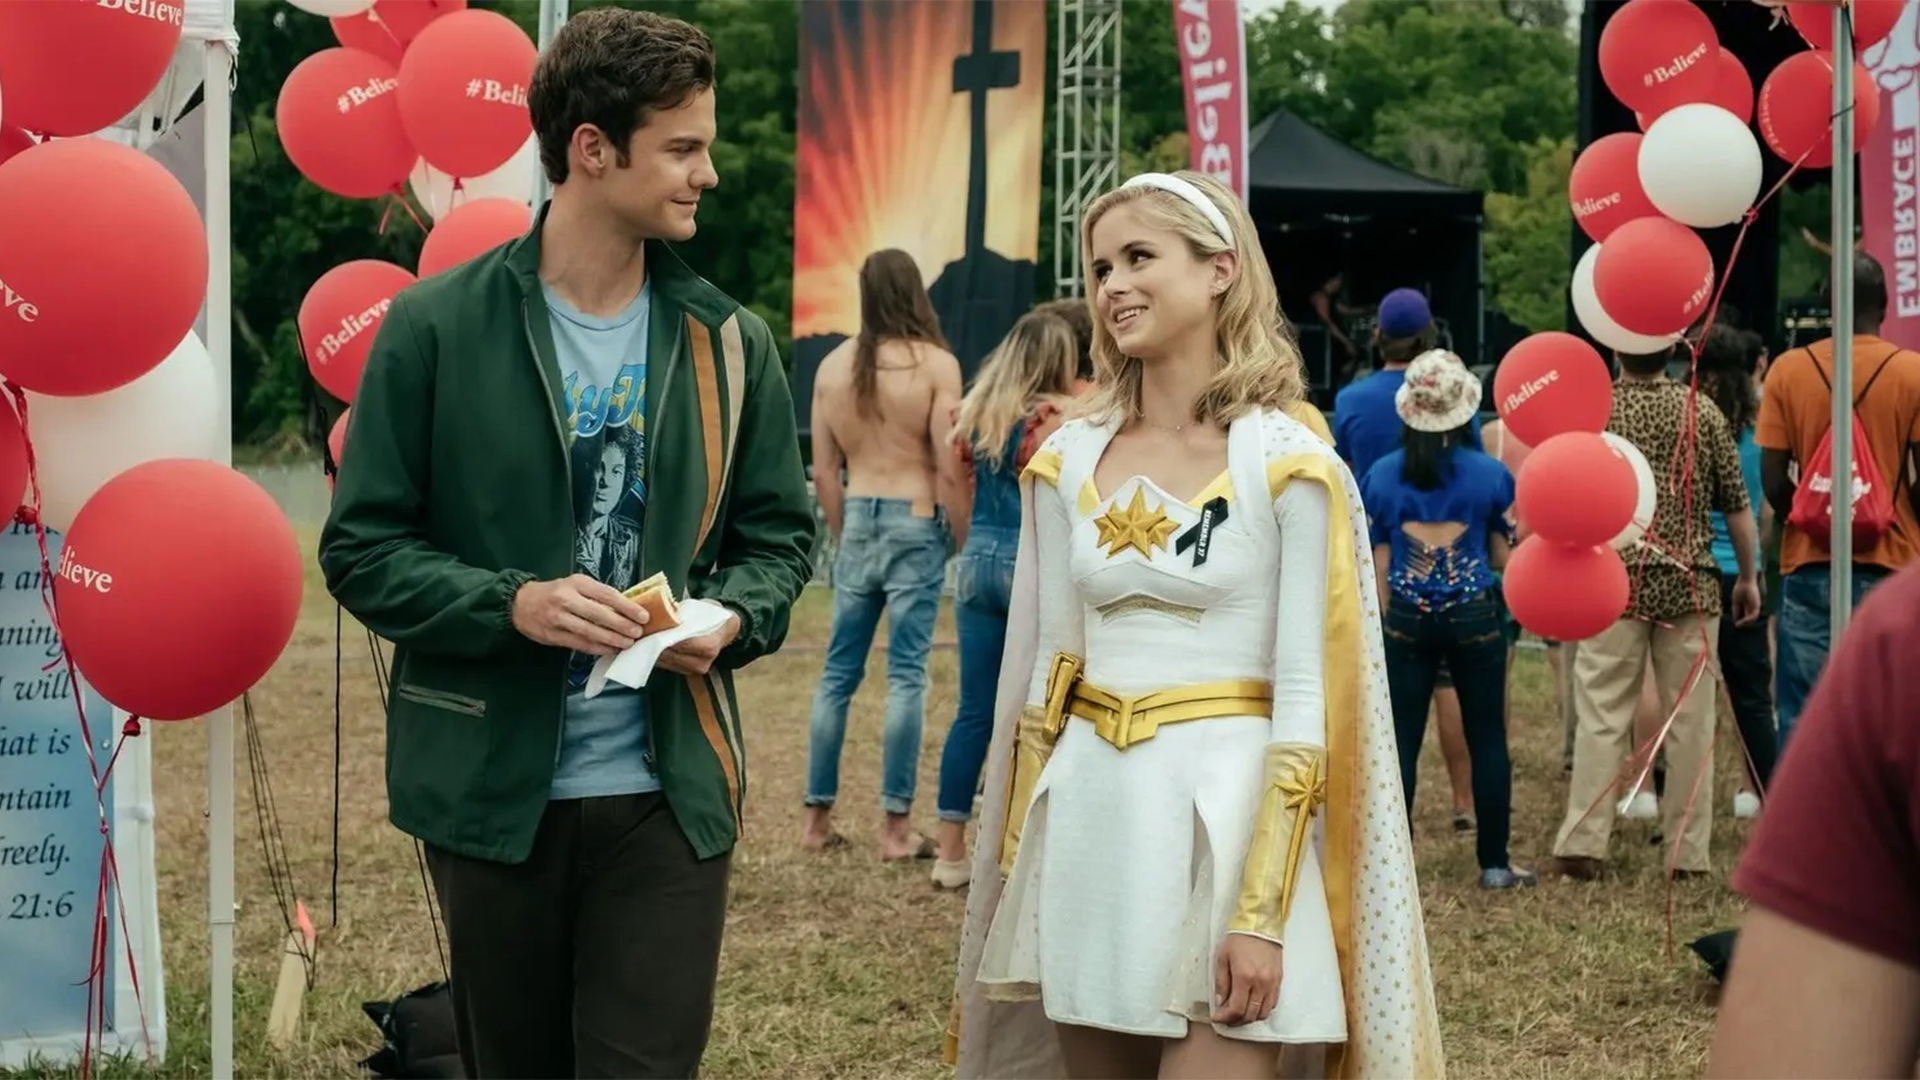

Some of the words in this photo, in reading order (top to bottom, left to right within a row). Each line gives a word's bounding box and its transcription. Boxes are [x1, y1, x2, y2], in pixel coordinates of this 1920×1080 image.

[1643, 42, 1707, 88] #Believe
[315, 297, 390, 366] #Believe
[1503, 369, 1560, 416] #Believe
[14, 669, 71, 701] will
[48, 728, 71, 755] is
[8, 890, 75, 920] 21:6
